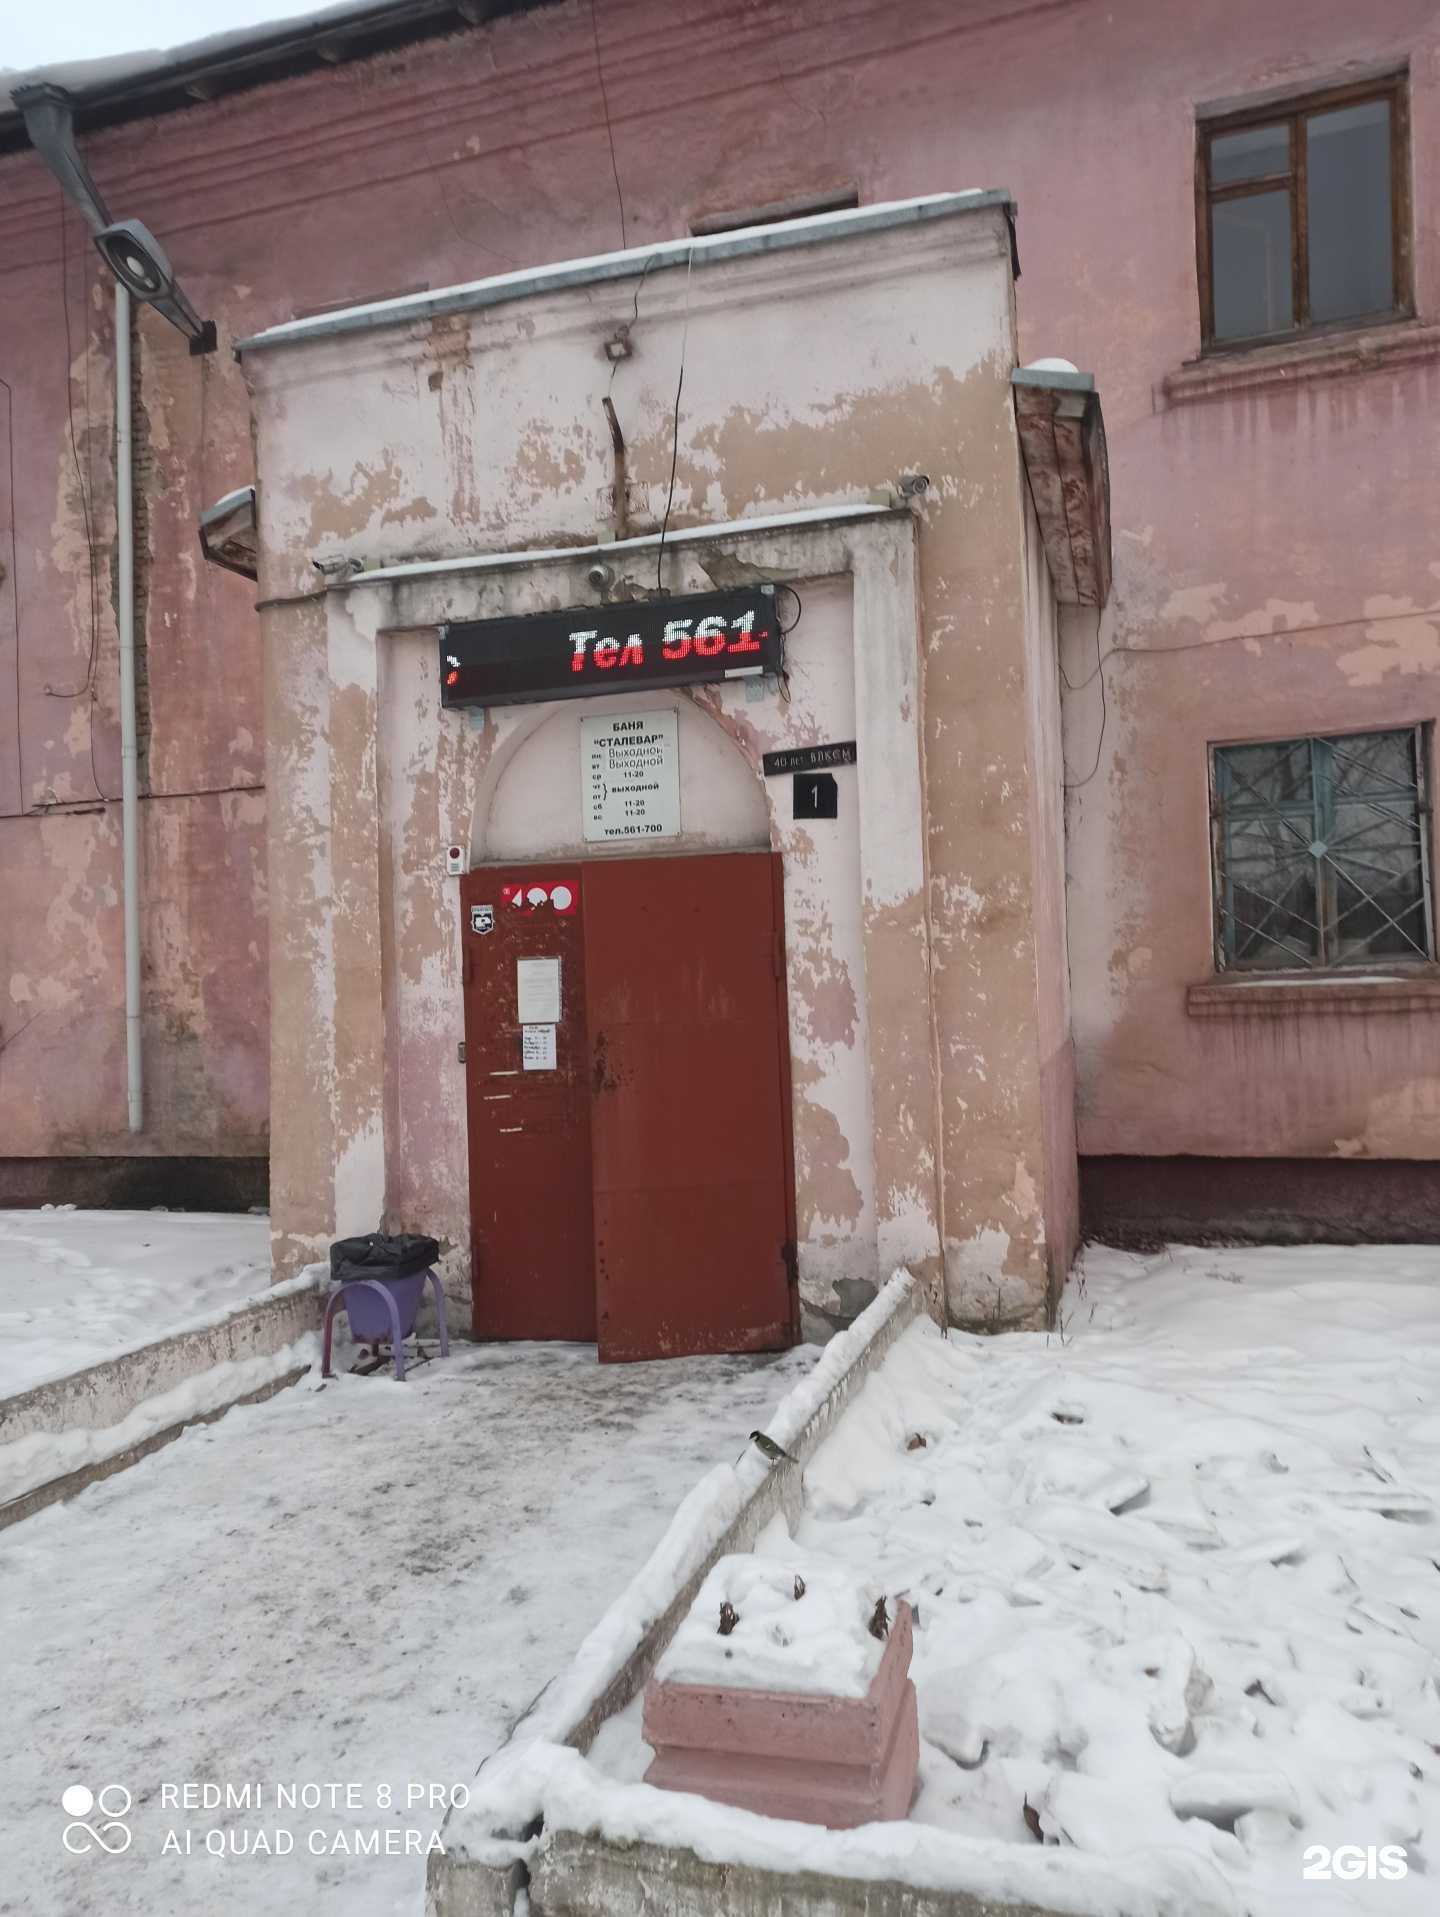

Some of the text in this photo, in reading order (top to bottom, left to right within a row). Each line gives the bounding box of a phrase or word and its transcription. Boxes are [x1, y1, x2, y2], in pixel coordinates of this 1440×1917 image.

[568, 630, 645, 672] Тел
[612, 720, 644, 732] БАНЯ
[593, 733, 664, 748] "СТАЛЕВАР"
[608, 746, 664, 759] Выходной
[609, 756, 664, 770] Выходной
[592, 770, 645, 781] ср 11-20
[611, 781, 660, 793] выходной
[811, 783, 819, 809] 1
[624, 799, 646, 808] 11-20
[624, 808, 646, 817] 11-20
[604, 823, 663, 836] тел.561-700
